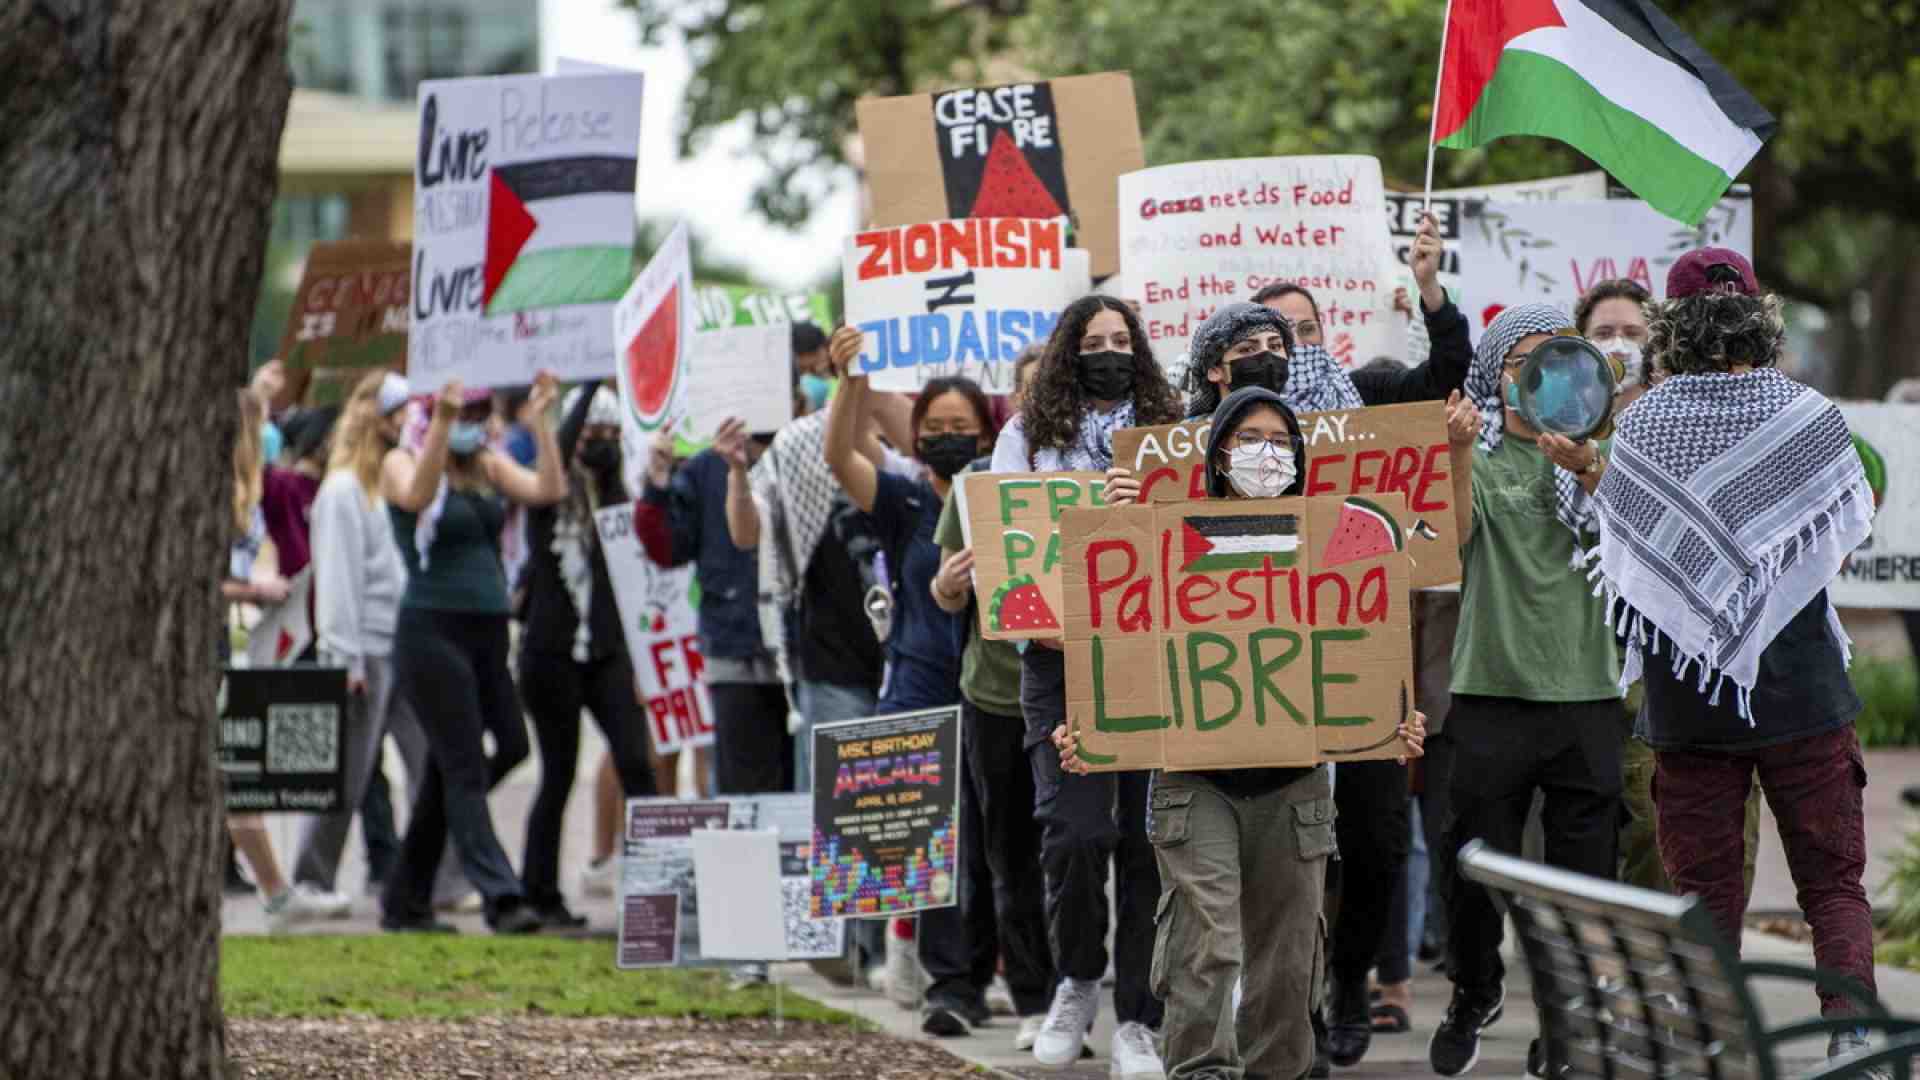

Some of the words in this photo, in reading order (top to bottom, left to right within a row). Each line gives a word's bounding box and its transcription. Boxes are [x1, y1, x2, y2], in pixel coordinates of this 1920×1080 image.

[502, 84, 613, 152] Release
[935, 84, 1037, 127] CEASE
[419, 92, 489, 188] Livre
[1140, 195, 1205, 220] Gaza
[1210, 182, 1281, 208] needs
[1292, 178, 1355, 206] Food
[856, 216, 1062, 281] ZIONISM
[1200, 223, 1241, 247] and
[1256, 221, 1345, 247] Water
[1144, 277, 1190, 303] End
[1197, 275, 1237, 295] the
[1148, 319, 1190, 340] End
[1085, 528, 1390, 633] Palestina
[1091, 627, 1375, 732] LIBRE
[837, 740, 871, 760] MSC
[871, 732, 937, 755] BIRTHDAY
[832, 751, 942, 798] ARCADE
